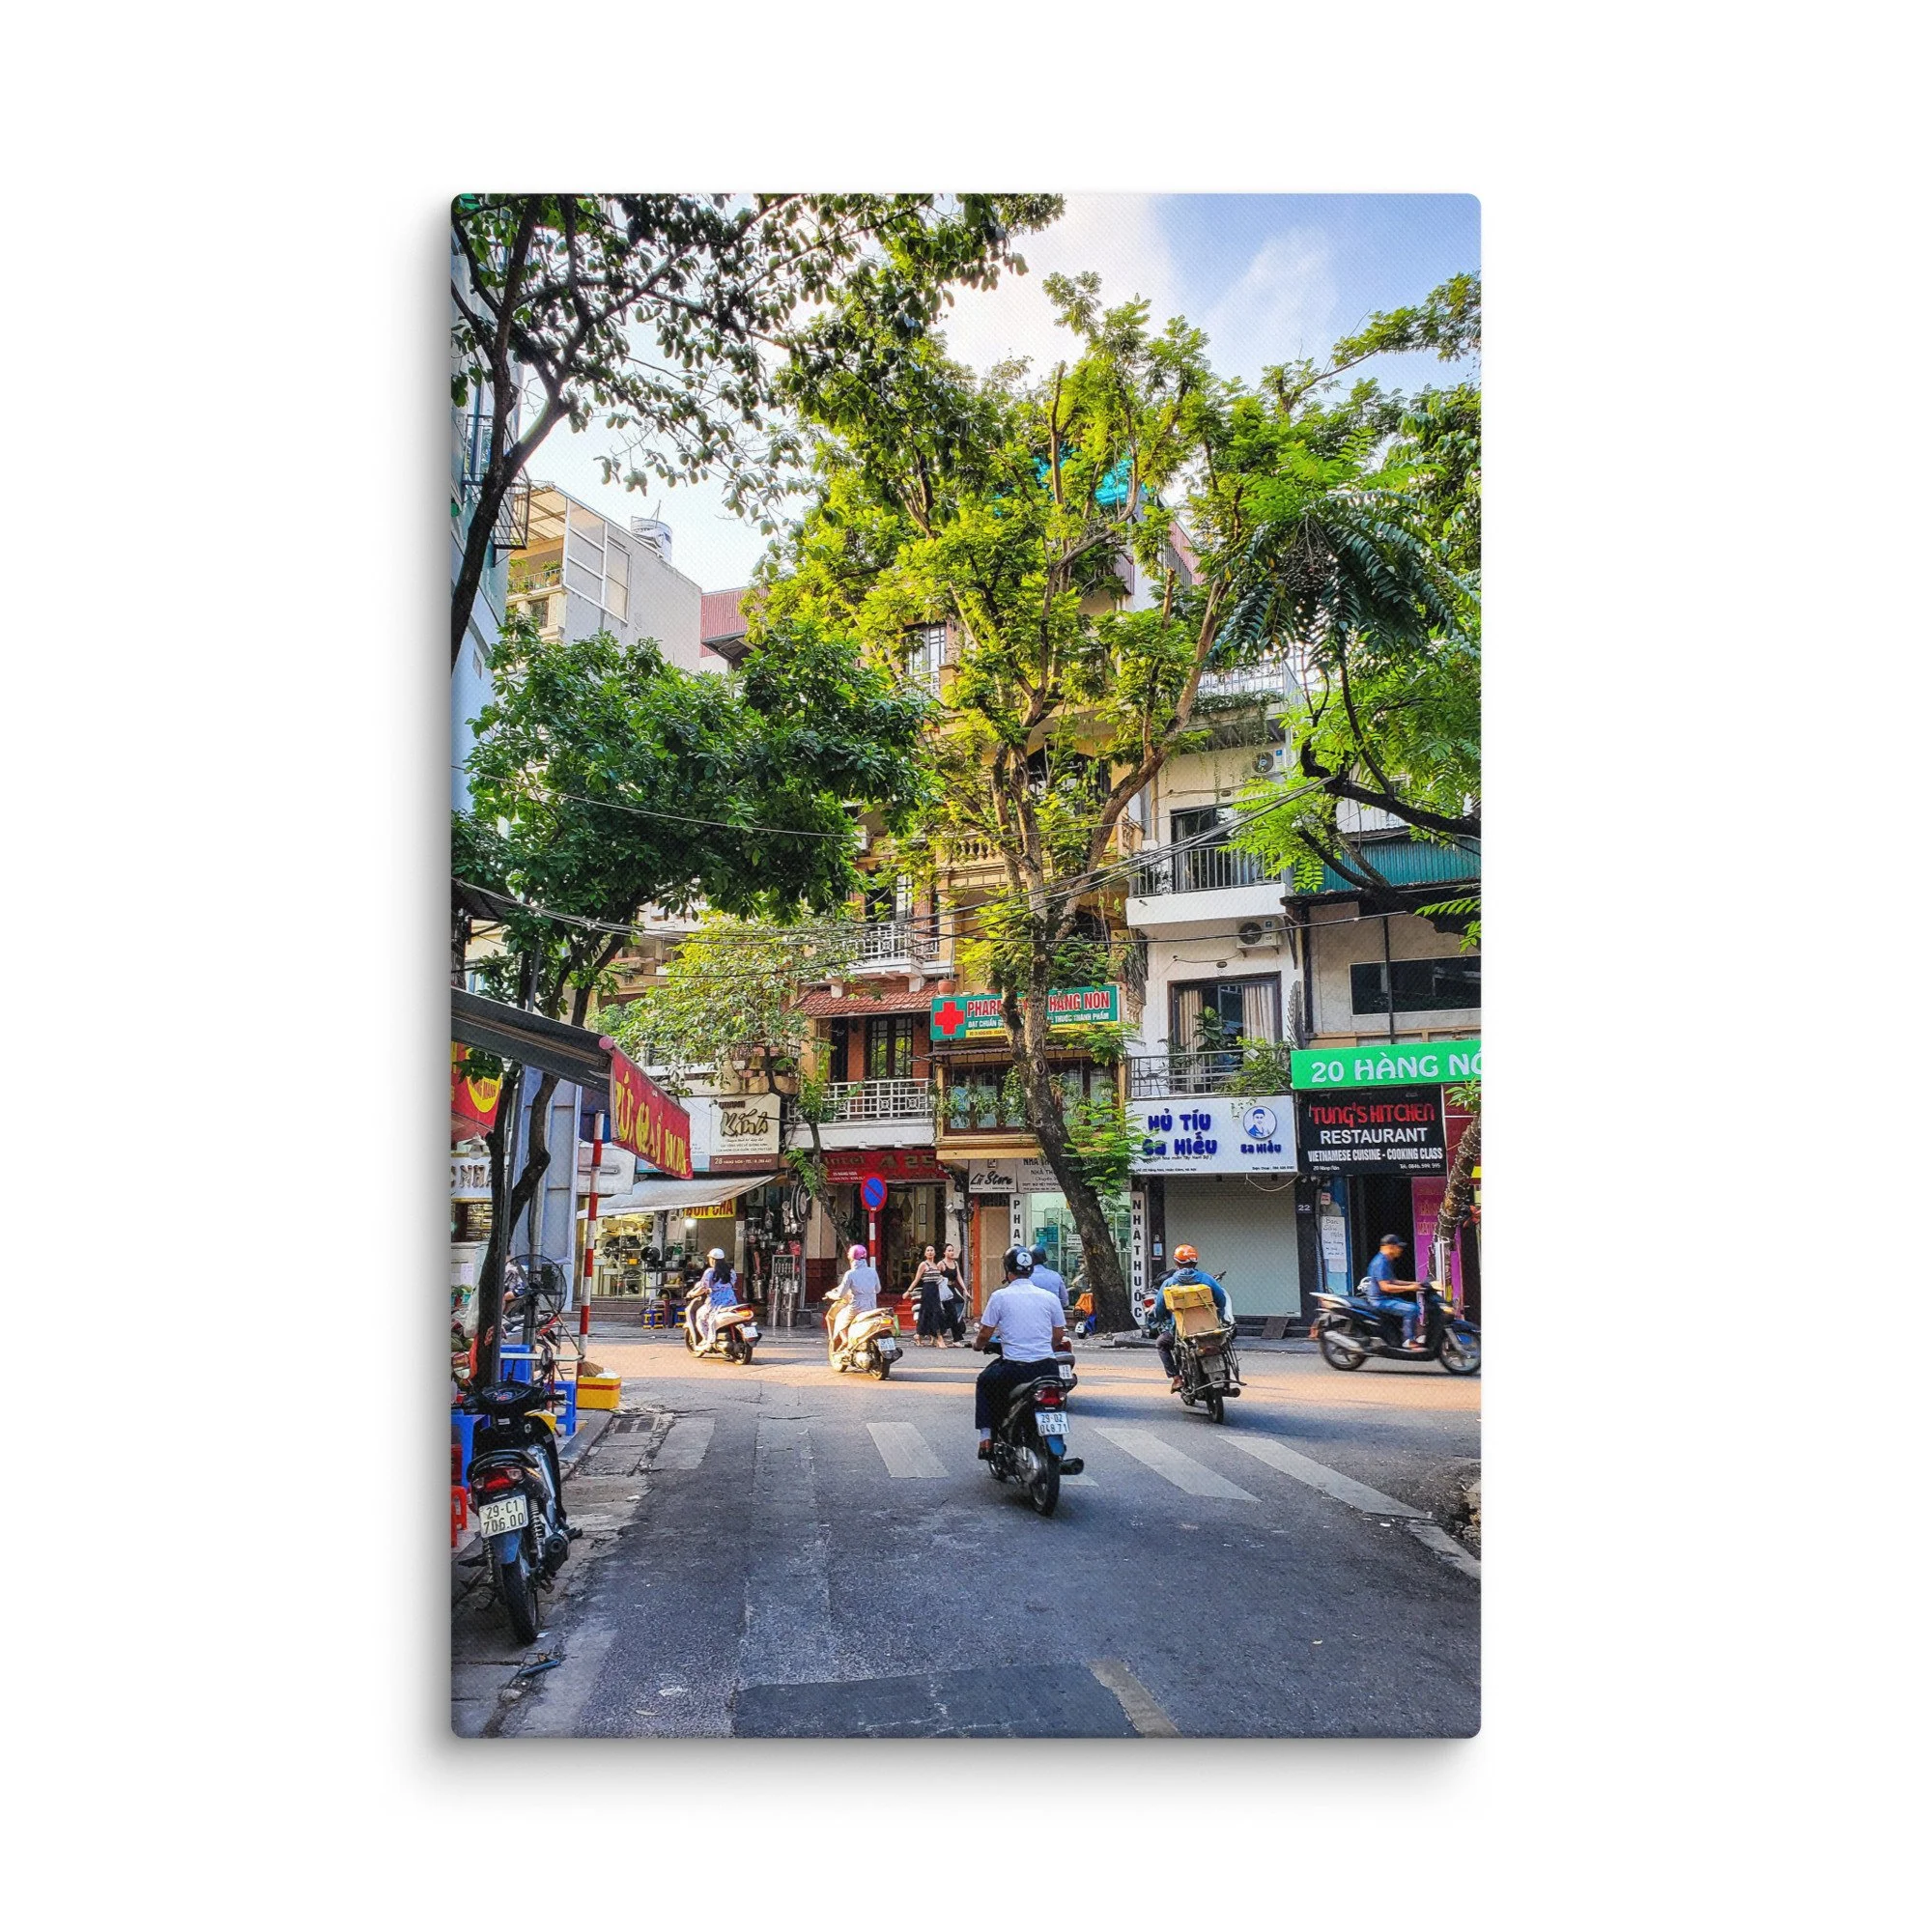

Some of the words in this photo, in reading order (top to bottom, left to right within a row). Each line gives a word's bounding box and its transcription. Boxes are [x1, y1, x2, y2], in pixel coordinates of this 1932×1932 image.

[1311, 1062, 1345, 1083] 20
[1354, 1052, 1439, 1080] HÀNG
[1148, 1108, 1172, 1131] HỦ
[1179, 1109, 1211, 1131] TÍU
[1321, 1128, 1428, 1145] RESTAURANT
[1308, 1150, 1351, 1162] VIETNAMESE
[1352, 1150, 1380, 1160] CUISINE
[1386, 1149, 1418, 1159] COOKING
[1420, 1148, 1442, 1159] CLASS
[487, 1499, 519, 1520] 29-C1
[484, 1513, 525, 1534] 706.00
